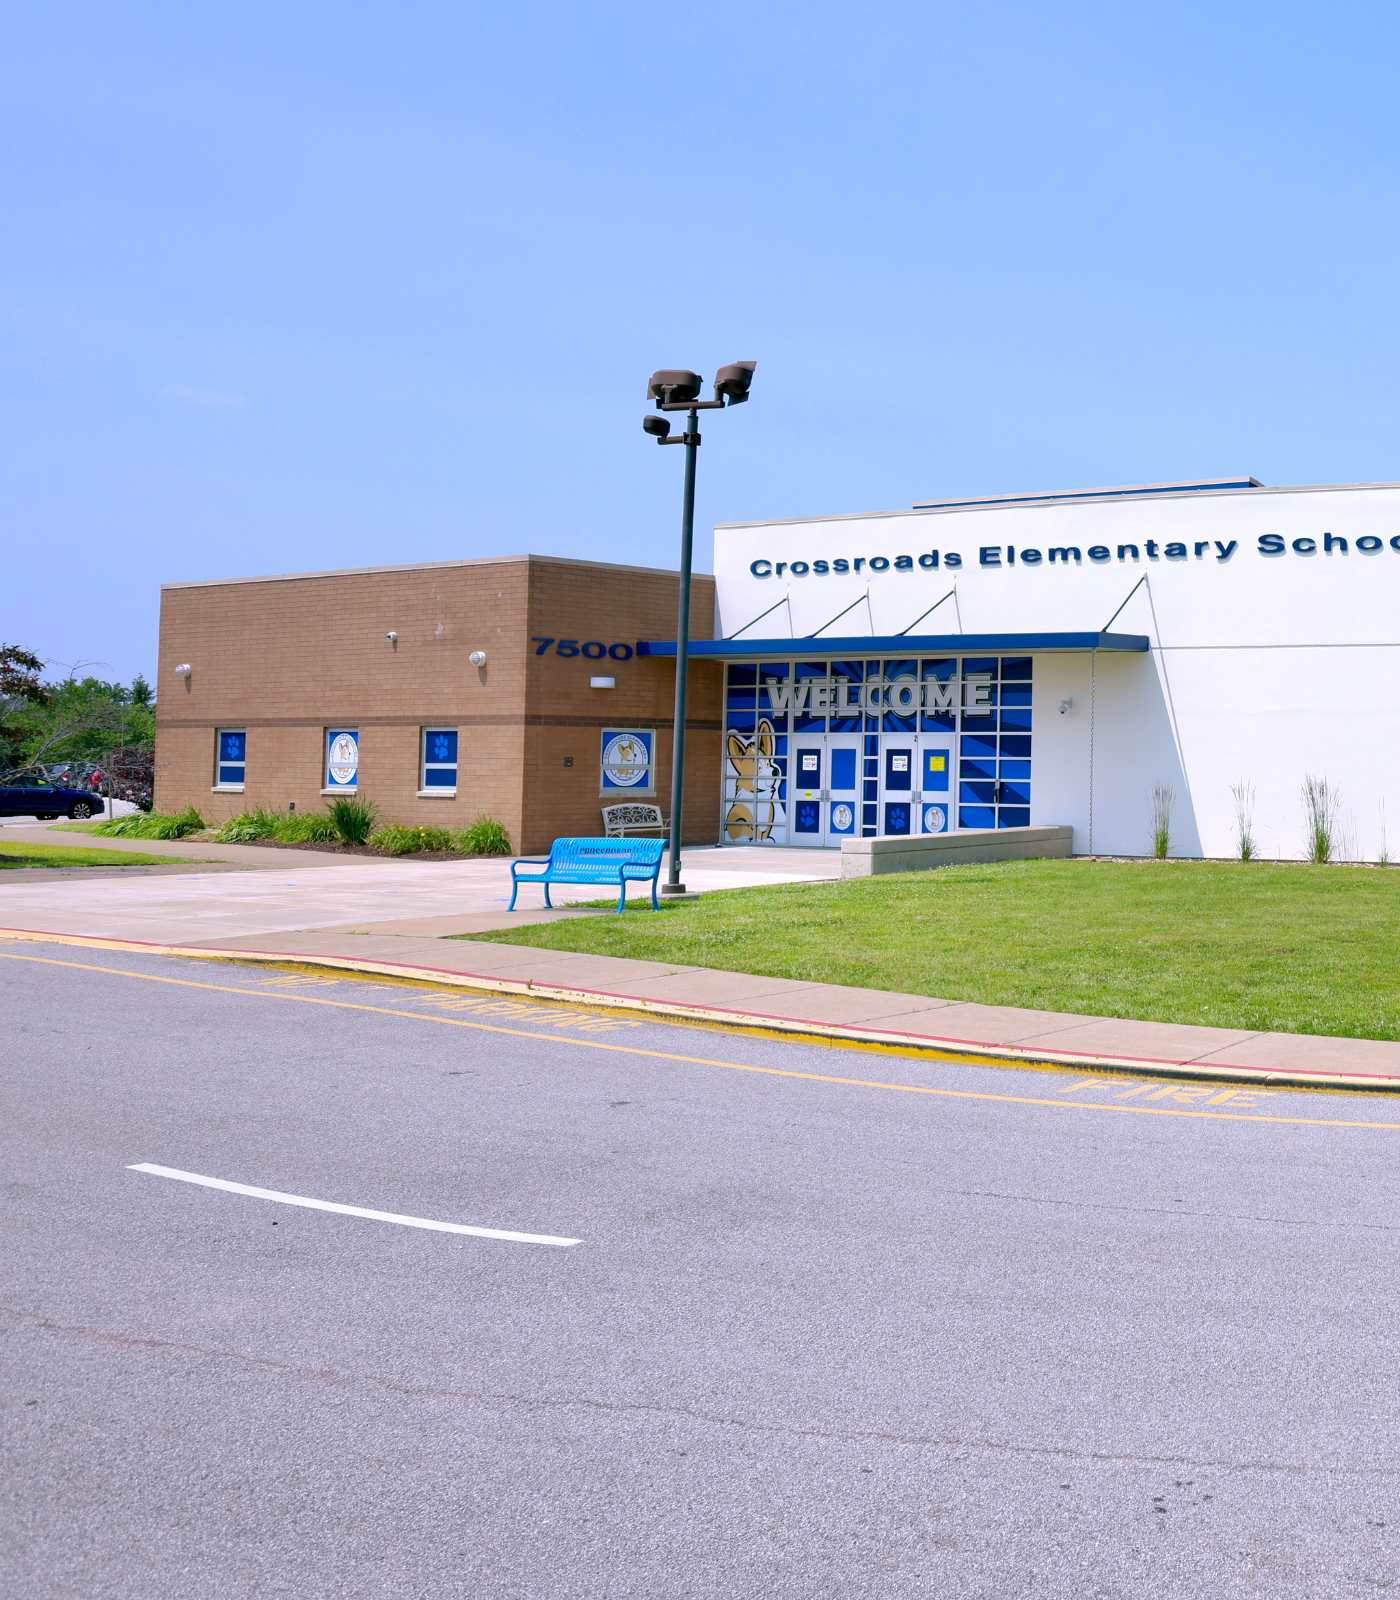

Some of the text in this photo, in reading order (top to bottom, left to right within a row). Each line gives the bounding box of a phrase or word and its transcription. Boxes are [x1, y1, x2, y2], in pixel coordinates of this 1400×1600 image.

[749, 548, 963, 577] Crossroads
[979, 539, 1237, 565] Elementary
[532, 637, 633, 661] 7500
[766, 672, 993, 719] WELCOME
[578, 847, 632, 859] CROSSROADS
[1057, 1079, 1278, 1108] FIRE
